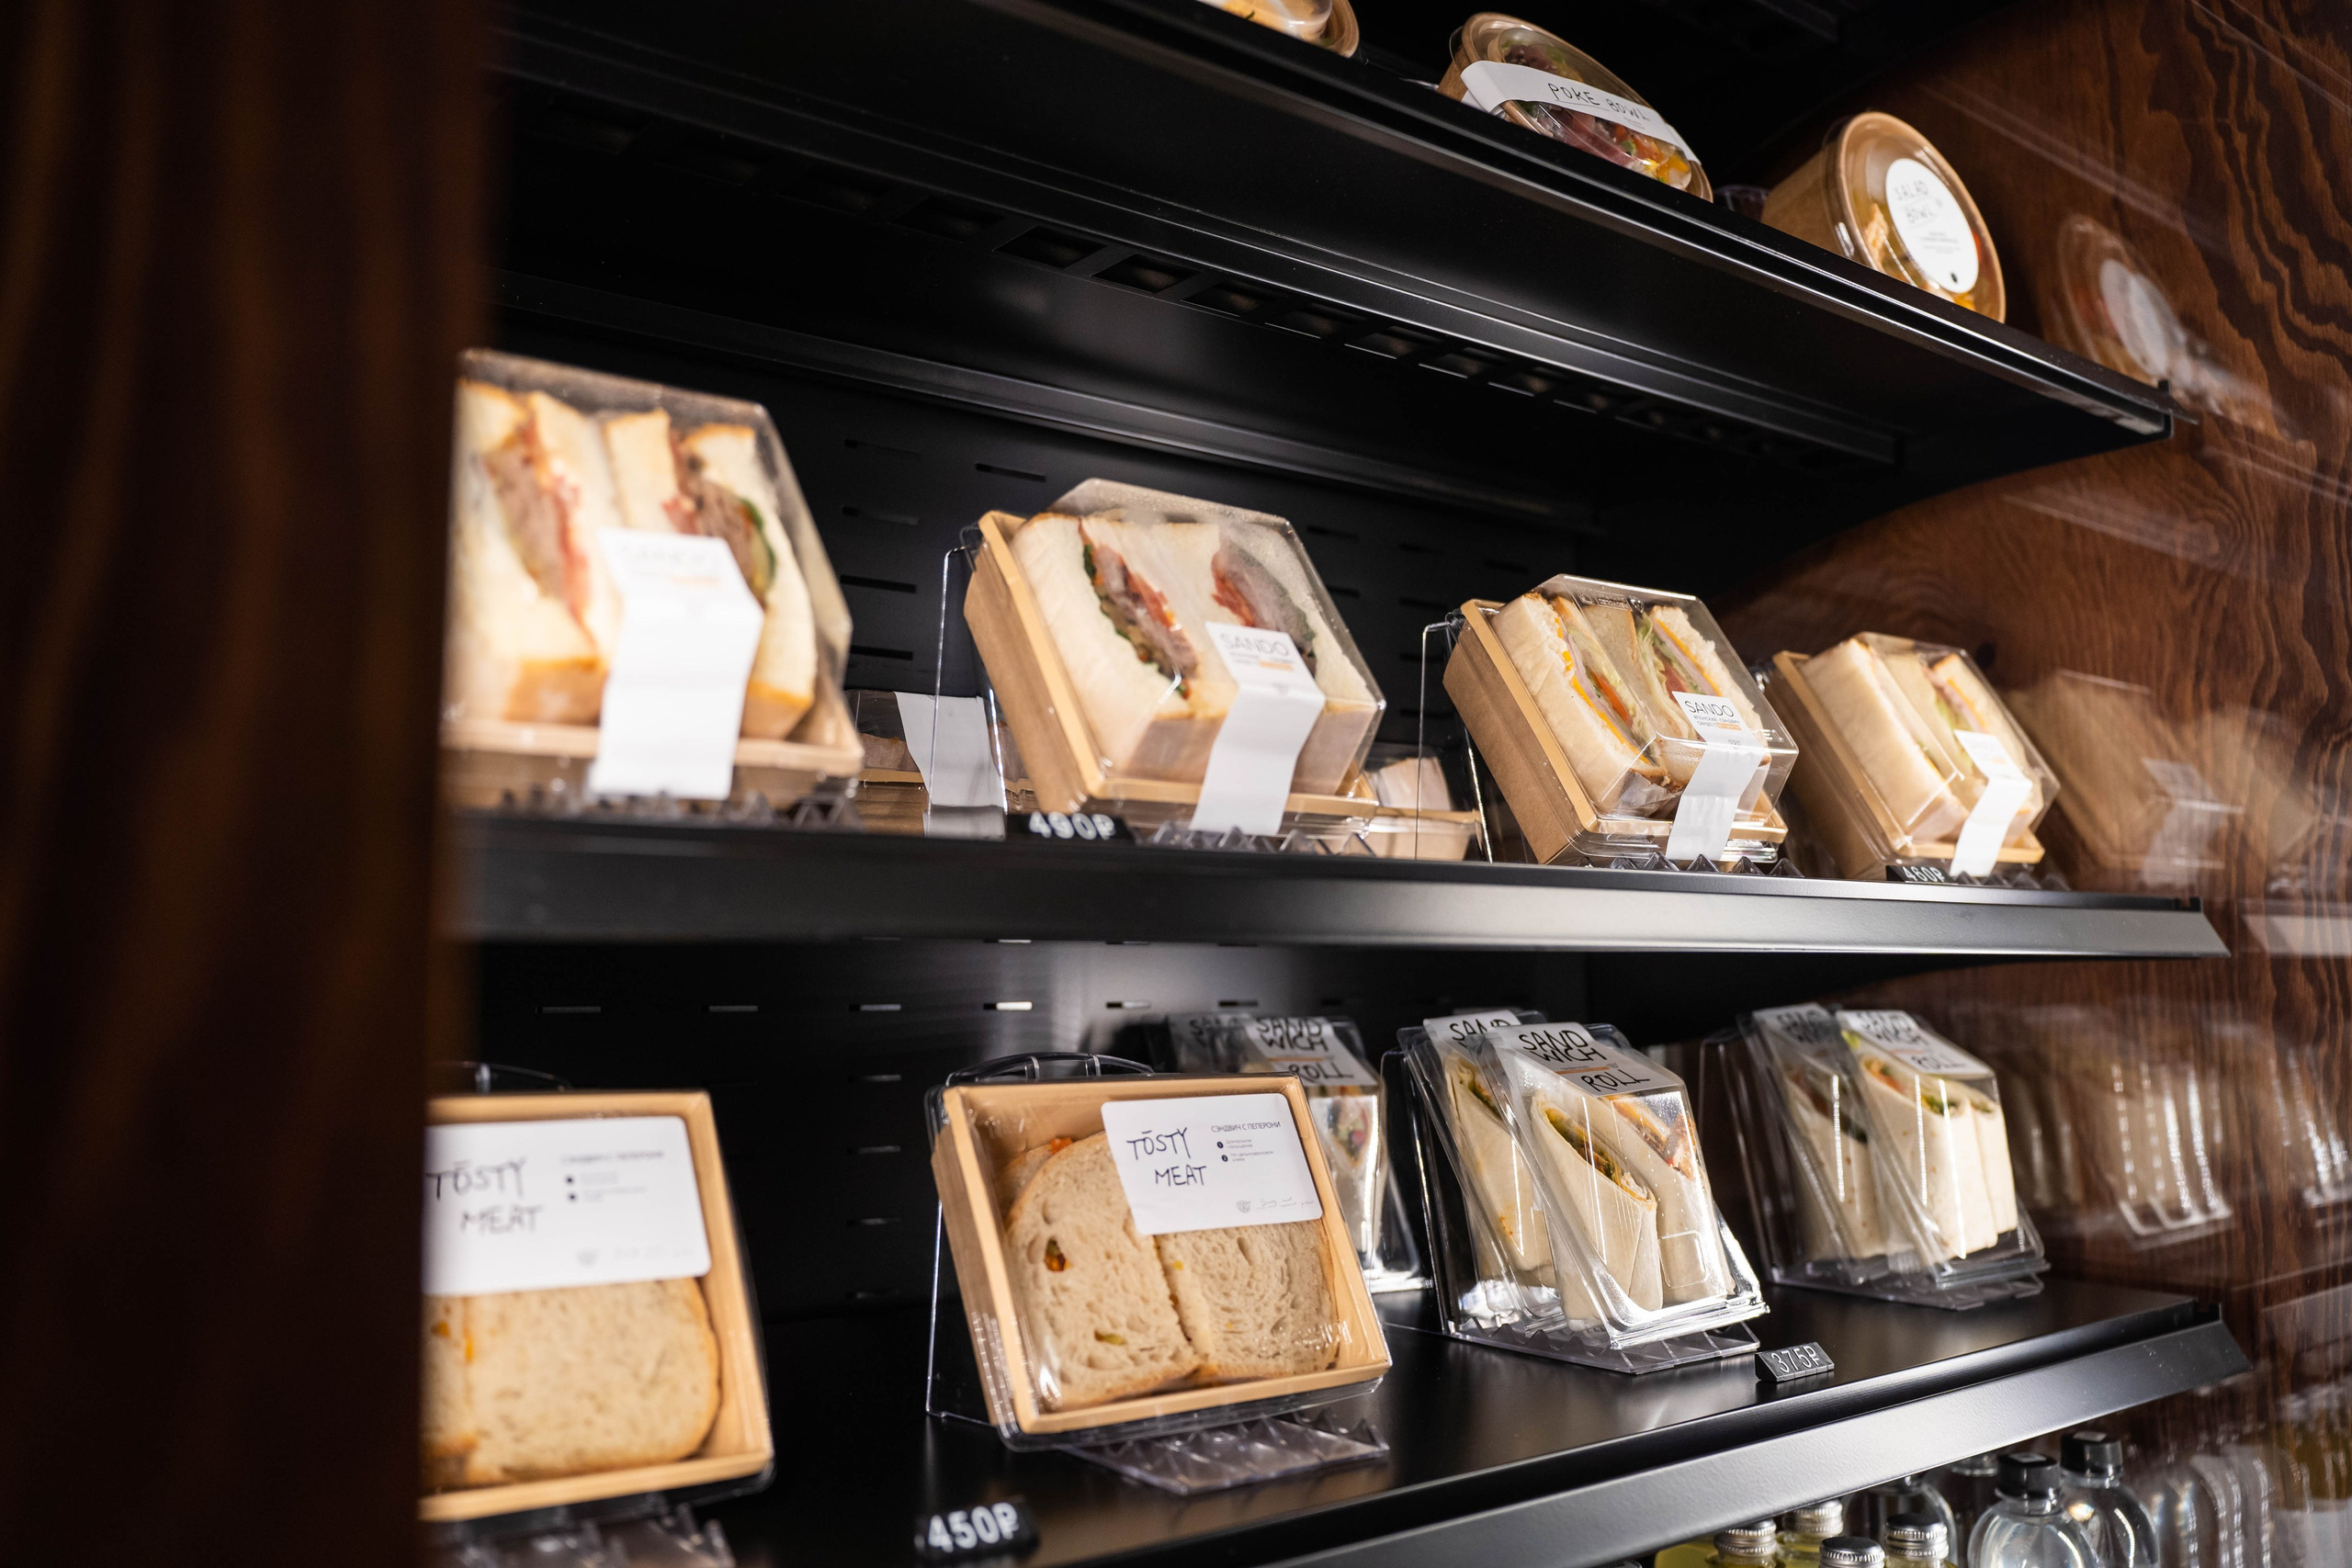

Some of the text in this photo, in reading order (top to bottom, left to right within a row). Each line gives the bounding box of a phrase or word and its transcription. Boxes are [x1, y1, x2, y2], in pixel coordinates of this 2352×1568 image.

[1547, 83, 1651, 121] POKE BOWL
[1219, 633, 1290, 657] SANDO
[1684, 700, 1735, 717] SANDO
[1260, 1033, 1329, 1052] WICH
[1519, 1030, 1589, 1052] SAND
[1529, 1046, 1608, 1064] WICH
[1580, 1068, 1651, 1092] ROLL
[1248, 1121, 1282, 1130] ПЕПЕРОНИ
[1154, 1164, 1207, 1187] MEAT
[461, 1204, 546, 1234] MEAT
